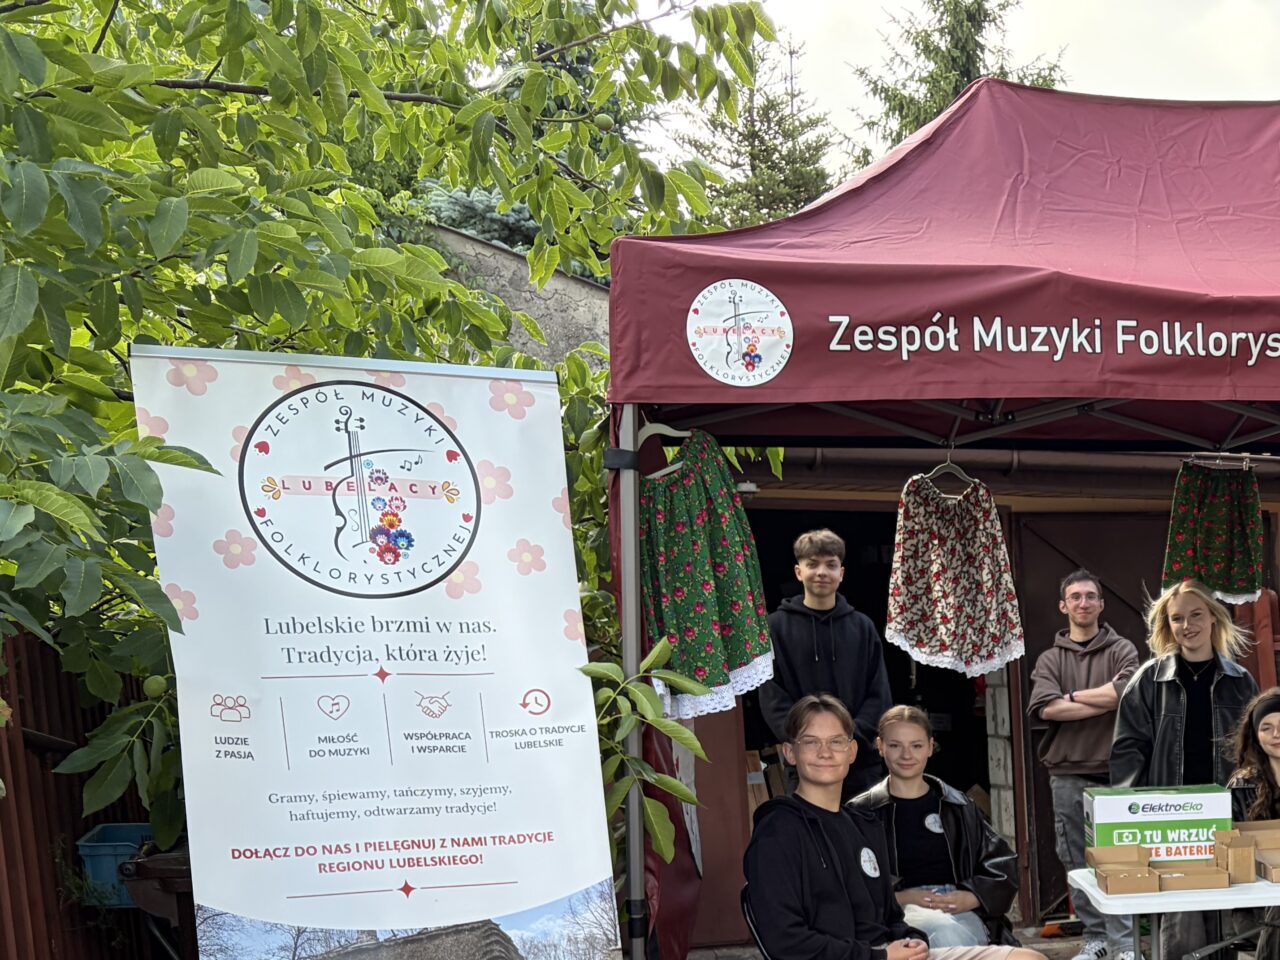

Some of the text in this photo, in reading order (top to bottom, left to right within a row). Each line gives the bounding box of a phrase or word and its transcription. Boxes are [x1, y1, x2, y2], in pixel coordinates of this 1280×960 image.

[697, 281, 780, 309] ZESPÓŁ MUZYKI
[828, 312, 959, 360] Zespół
[973, 316, 1101, 361] Muzyki
[264, 389, 445, 445] ZESPÓŁ MUZYKI
[281, 479, 437, 495] LUBELACY
[260, 518, 471, 585] FOLKLORYSTYCZNEJ
[264, 616, 497, 636] Lubelskie brzmi w nas.
[281, 644, 487, 666] Tradycja, która żyje!
[317, 732, 359, 745] MIŁOŚĆ
[403, 730, 472, 741] WSPÓŁPRACA
[489, 724, 586, 739] TROSKA O TRADYCJE
[214, 736, 249, 746] LUDZIE
[416, 744, 467, 754] WSPARCIE
[514, 738, 564, 750] LUBELSKIE
[215, 750, 255, 761] Z PASJĄ
[309, 746, 370, 758] DO MUZYKI
[268, 784, 512, 805] Gramy, śpiewamy, tańczymy, szyjemy,
[289, 801, 497, 822] haftujemy, odtwarzamy tradycje!
[1141, 802, 1203, 812] ElektroEko
[1144, 824, 1216, 843] TU WRZUĆ
[231, 846, 291, 862] DOŁĄCZ
[294, 845, 317, 858] DO
[322, 843, 352, 856] NAS
[364, 838, 436, 854] PIELĘGNUJ
[440, 838, 448, 848] Z
[451, 835, 487, 848] NAMI
[490, 831, 554, 846] TRADYCJE
[1165, 845, 1215, 857] BATERIE
[318, 853, 484, 874] REGIONU LUBELSKIEGO!
